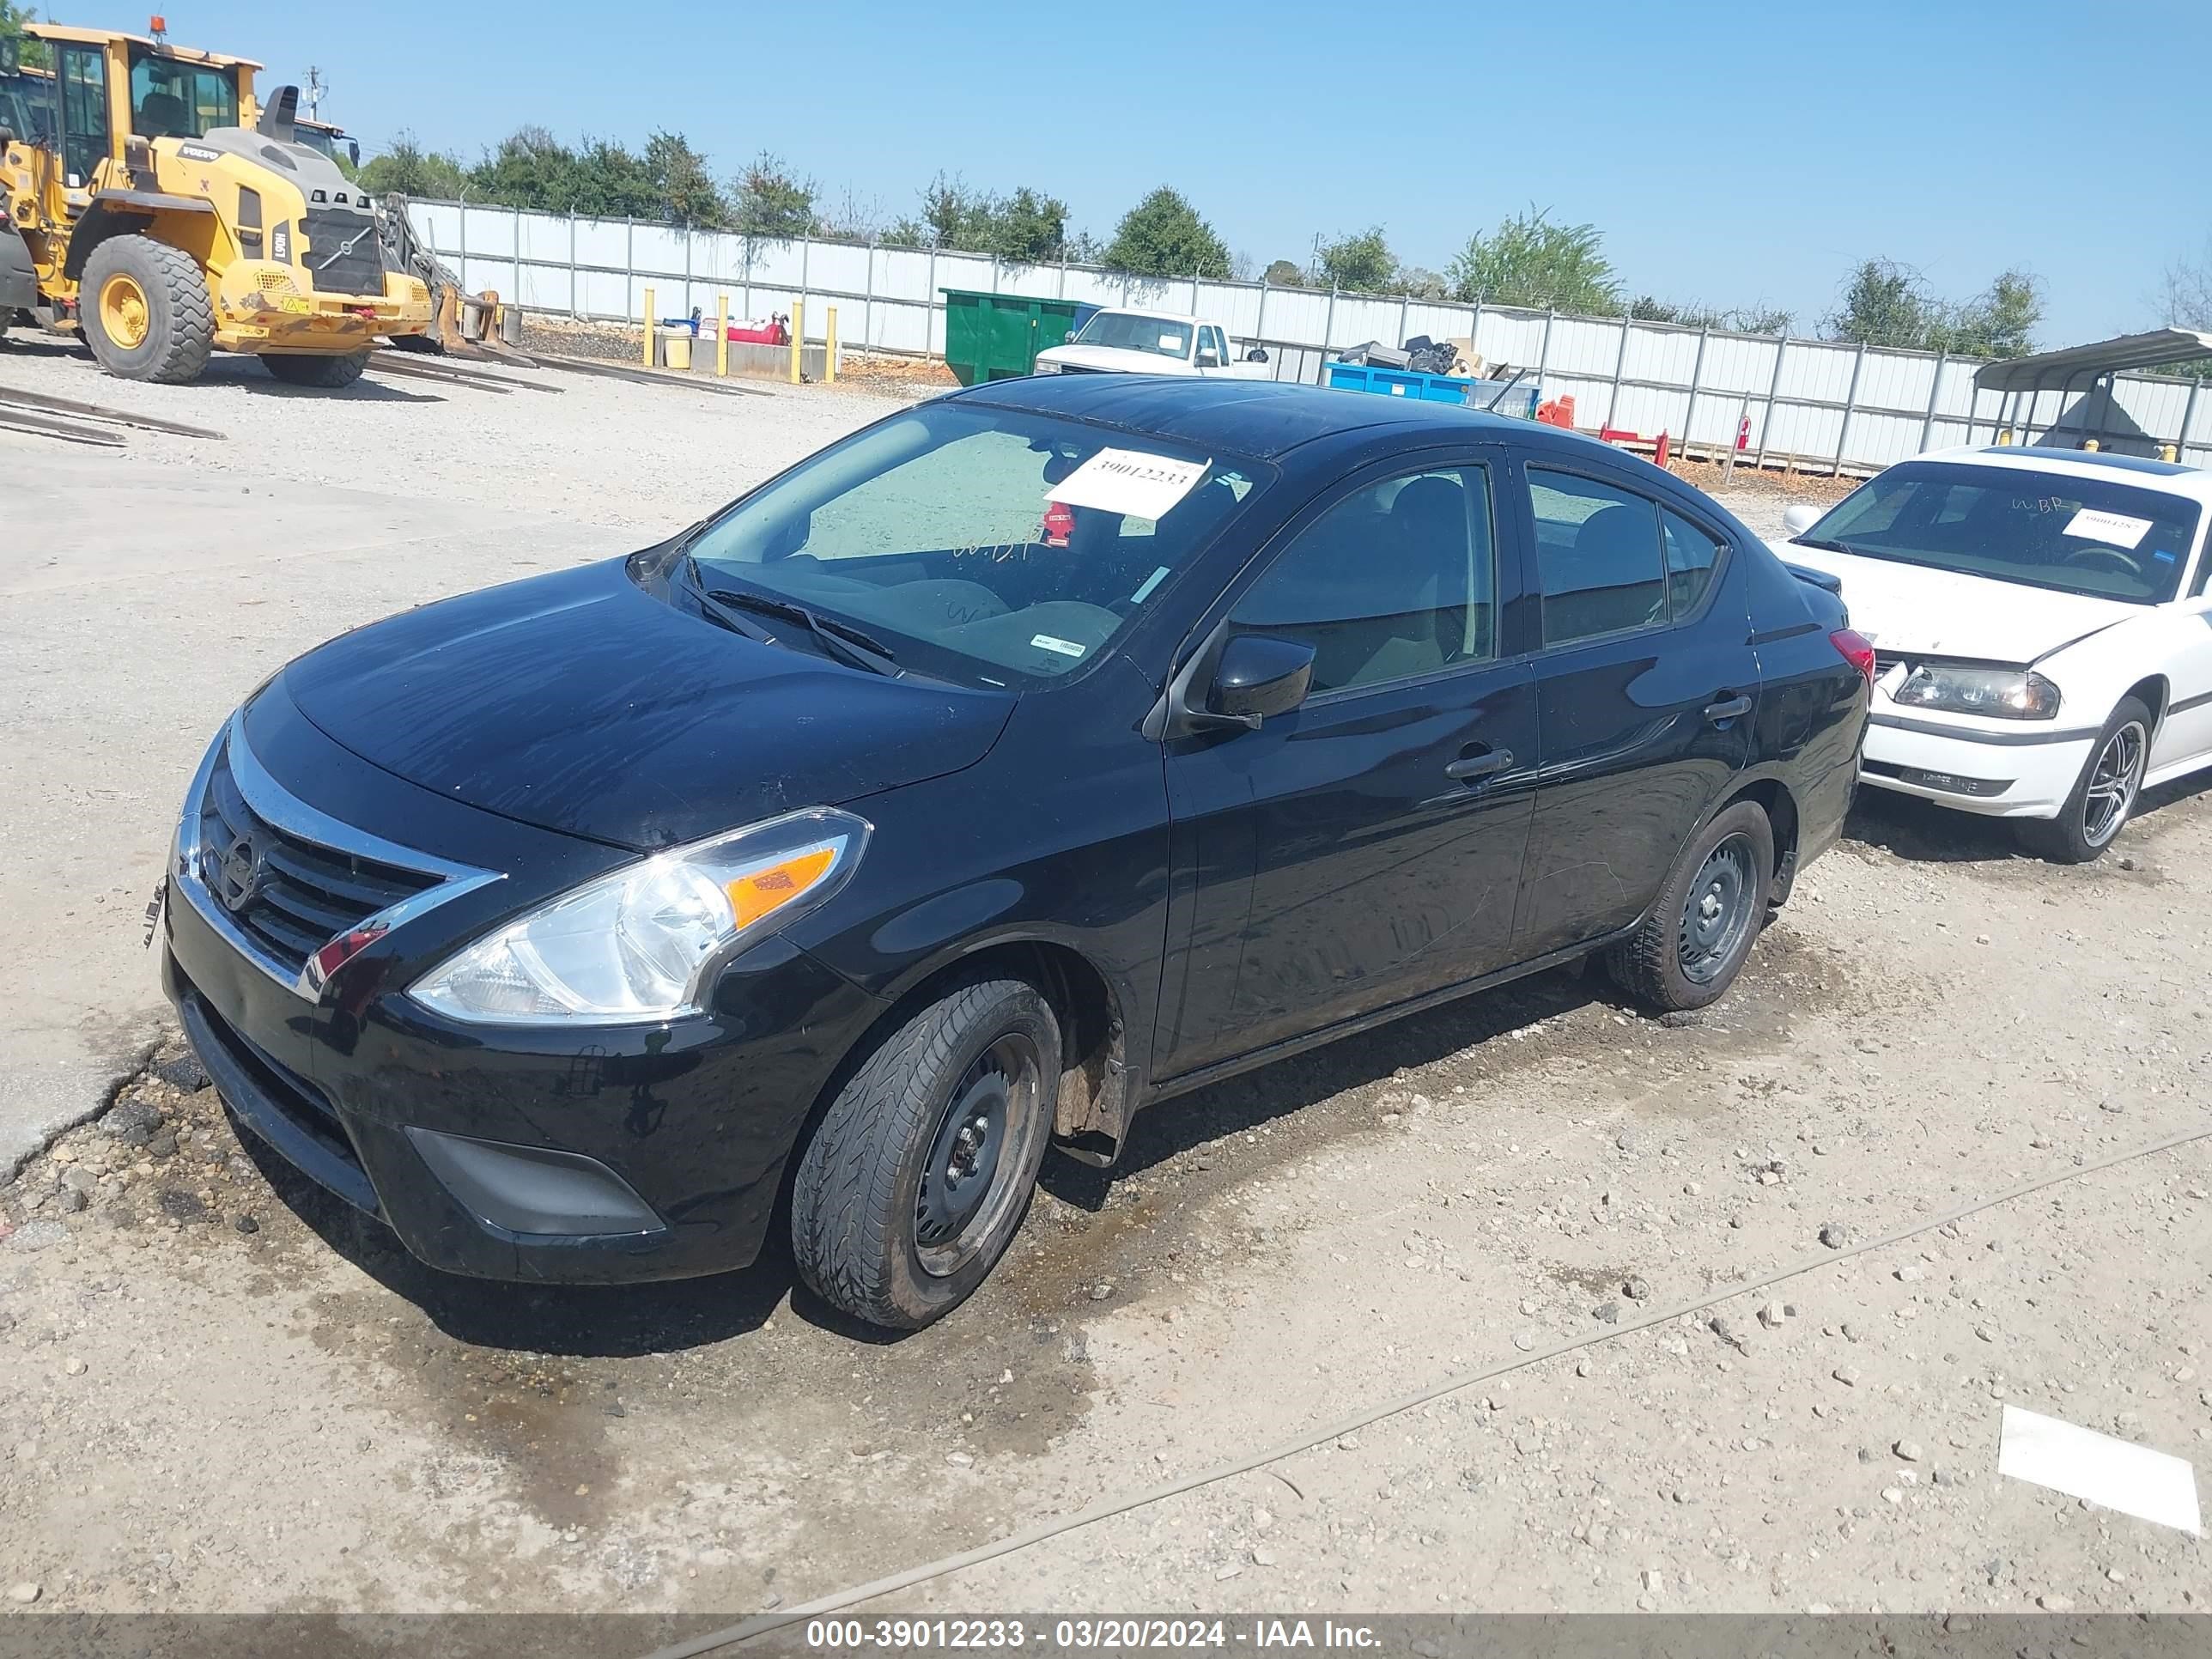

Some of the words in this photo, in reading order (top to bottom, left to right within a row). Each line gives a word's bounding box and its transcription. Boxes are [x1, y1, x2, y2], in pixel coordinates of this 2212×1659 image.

[183, 146, 219, 160] VOLVO
[275, 233, 286, 258] L90H
[1093, 460, 1188, 485] 39012233
